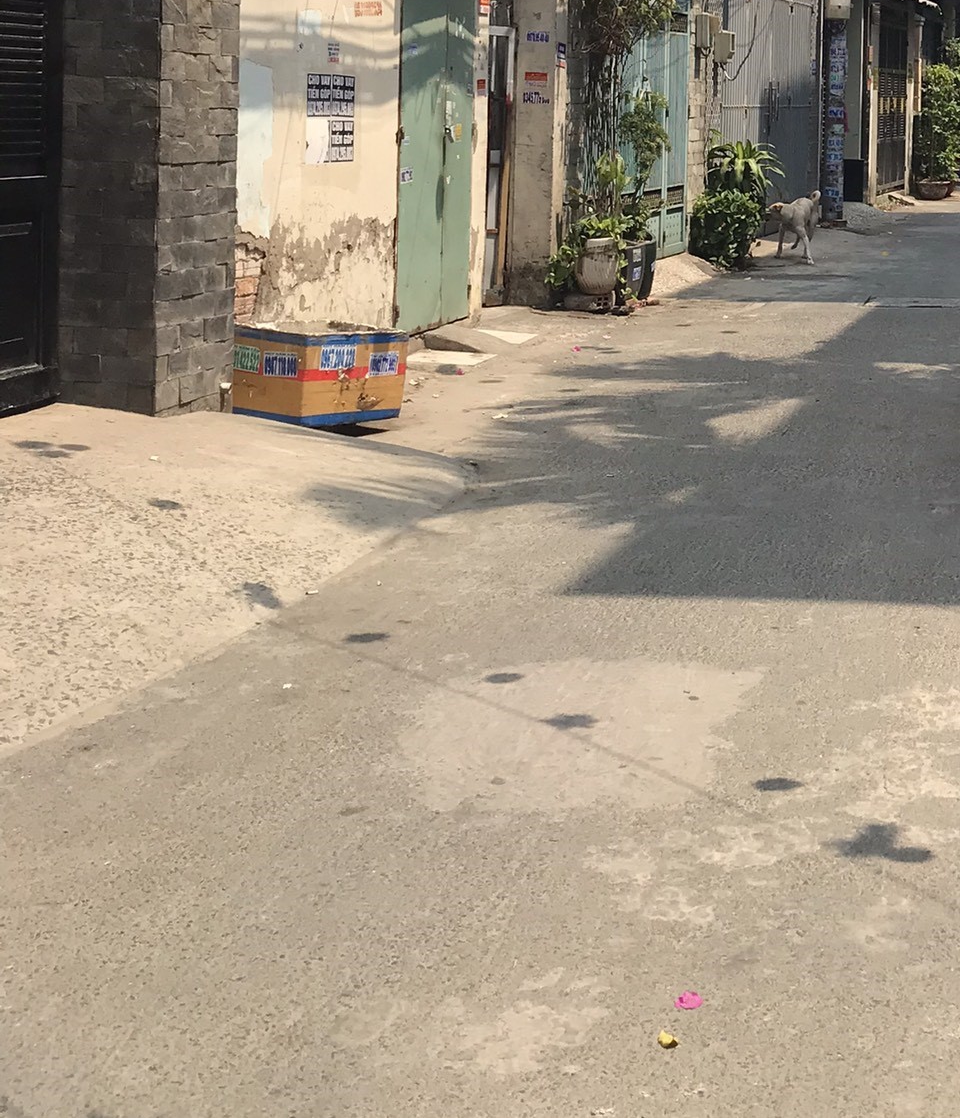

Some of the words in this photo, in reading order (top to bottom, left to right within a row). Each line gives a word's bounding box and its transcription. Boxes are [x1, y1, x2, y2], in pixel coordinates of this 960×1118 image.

[308, 74, 320, 85] CHO
[321, 75, 331, 86] VAY
[333, 75, 344, 86] CHO
[345, 76, 355, 87] VAY
[332, 121, 343, 131] CHO
